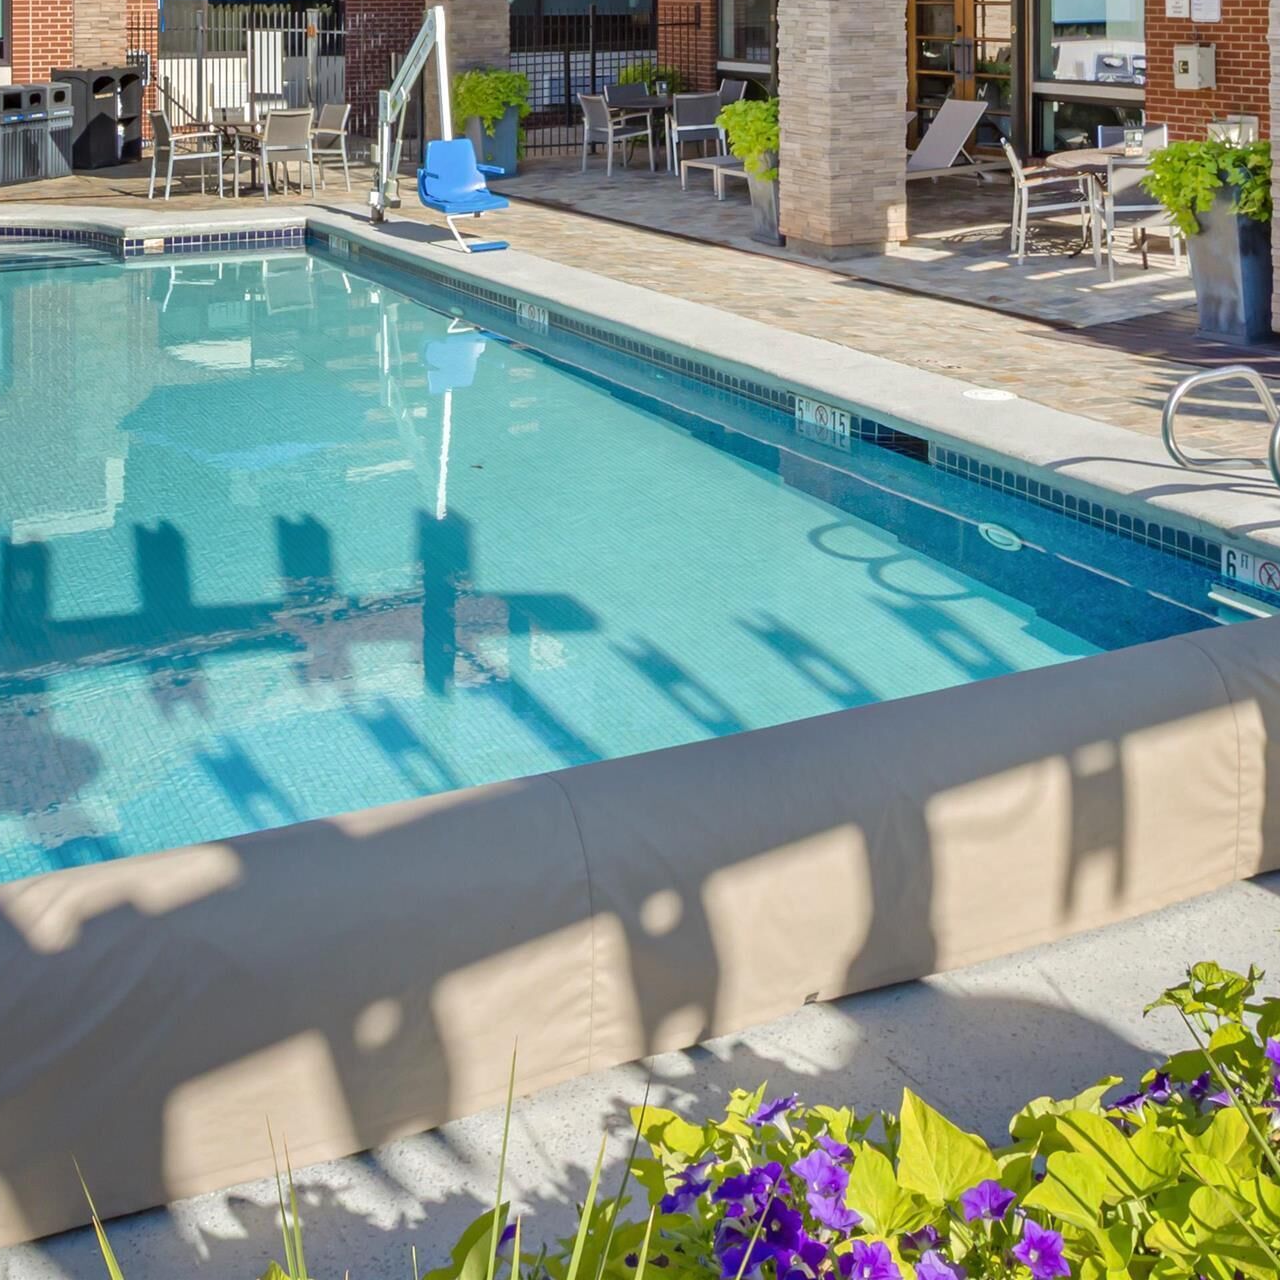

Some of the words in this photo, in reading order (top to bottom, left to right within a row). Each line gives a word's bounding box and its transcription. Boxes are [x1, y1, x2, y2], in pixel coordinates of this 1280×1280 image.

[797, 398, 804, 422] 5
[1226, 549, 1237, 579] 6
[1241, 553, 1249, 570] FT
